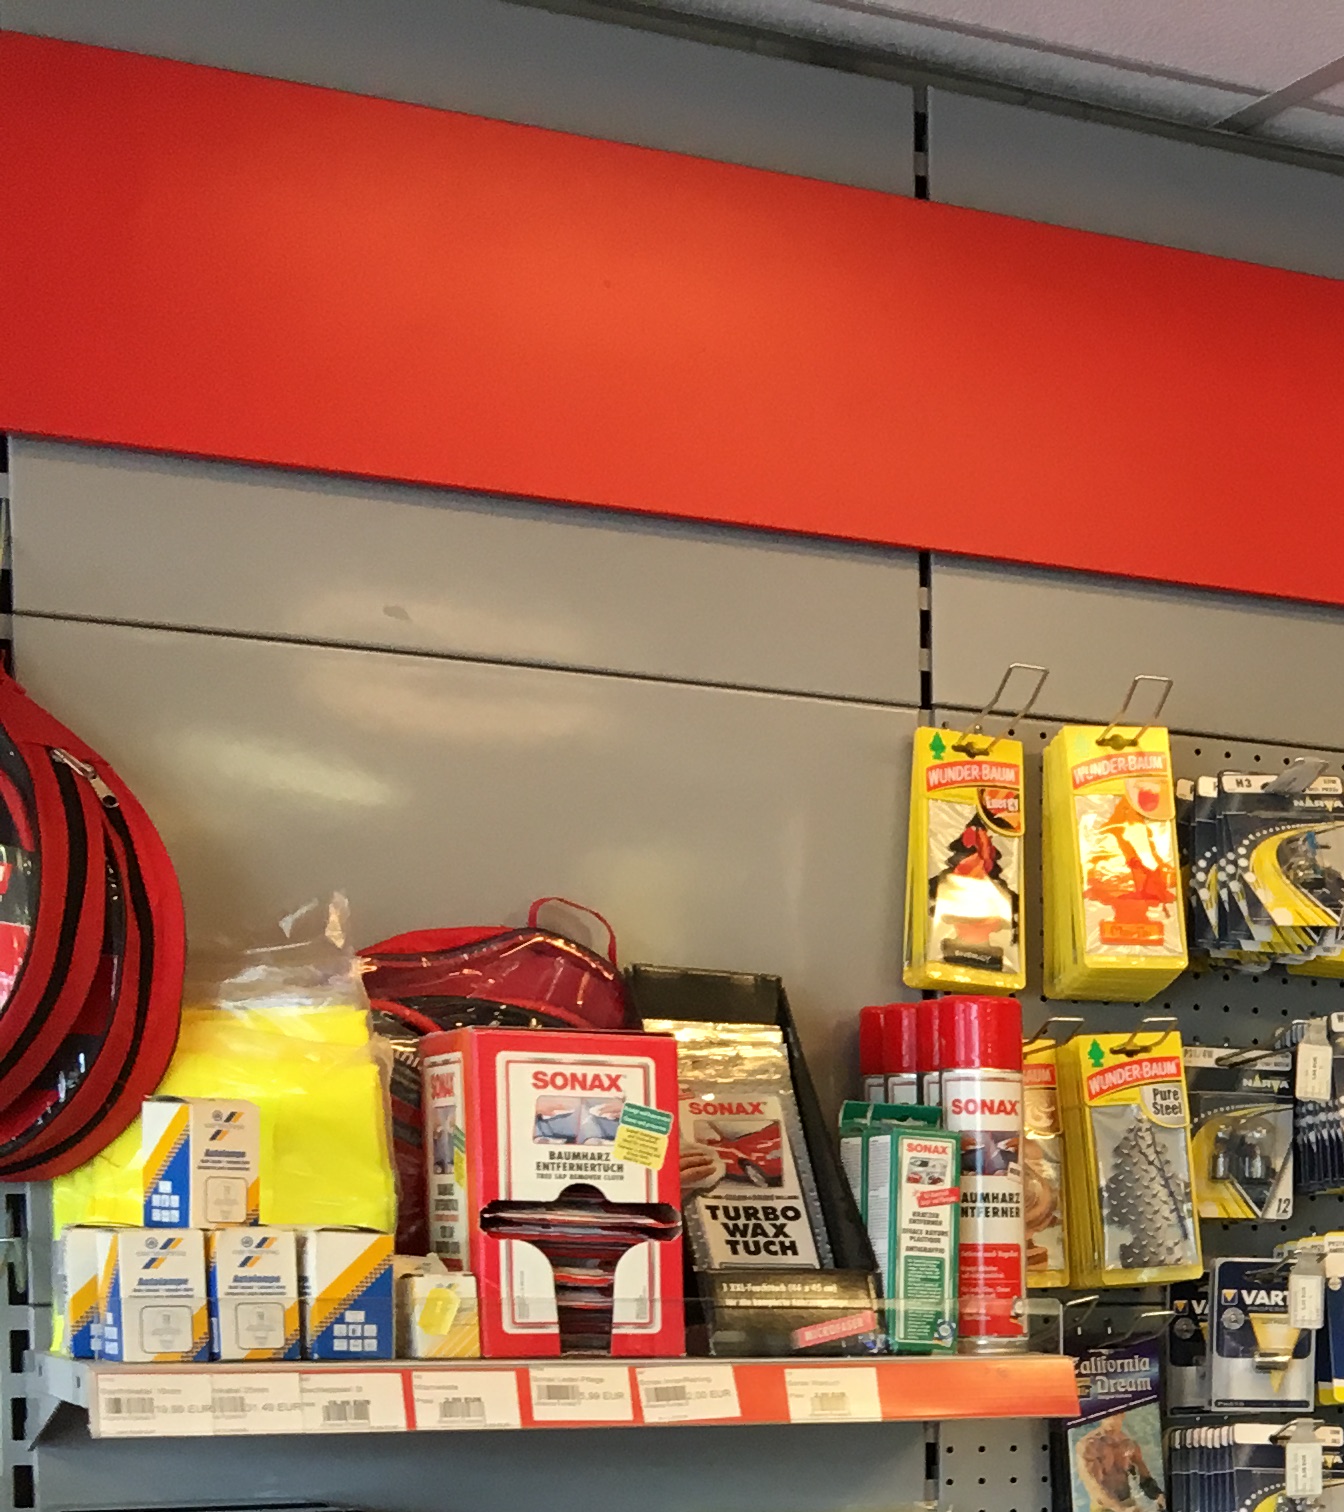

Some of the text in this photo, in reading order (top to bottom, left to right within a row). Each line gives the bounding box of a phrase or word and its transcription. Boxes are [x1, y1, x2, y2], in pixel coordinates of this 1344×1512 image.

[928, 764, 1016, 785] WUNDER-BAUM
[1072, 755, 1166, 782] WUNDER-BAUM
[1235, 777, 1252, 790] H3
[531, 1071, 624, 1092] SONAX
[1089, 1062, 1177, 1092] WUNDER-BAUM
[1153, 1088, 1180, 1102] Pure
[689, 1101, 764, 1116] SONAX
[951, 1099, 1018, 1116] SONAX
[1152, 1101, 1182, 1116] Steel
[906, 1142, 948, 1154] SONAX
[548, 1151, 610, 1163] BAUMHARZ
[536, 1162, 624, 1174] ENTFERNERTUCH
[705, 1205, 800, 1222] TURBO
[720, 1222, 789, 1239] WAX
[725, 1239, 798, 1256] TUCH
[602, 1390, 624, 1399] EUR
